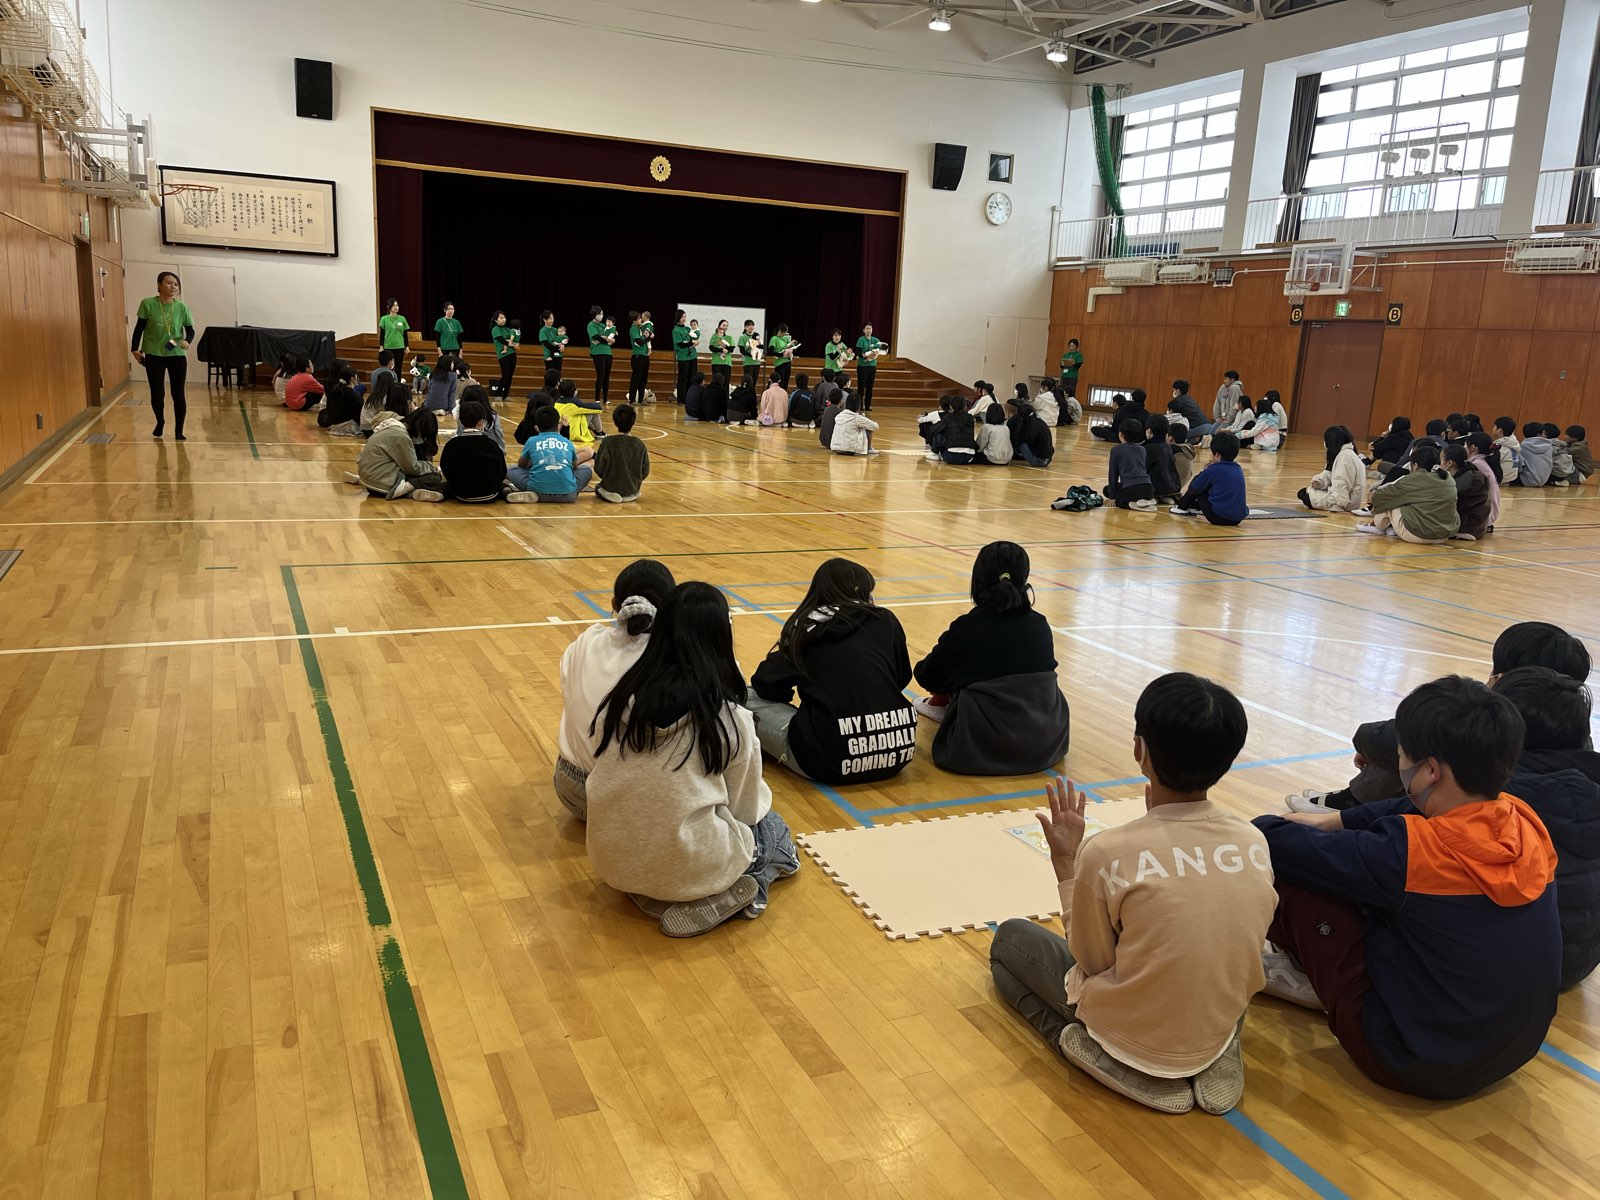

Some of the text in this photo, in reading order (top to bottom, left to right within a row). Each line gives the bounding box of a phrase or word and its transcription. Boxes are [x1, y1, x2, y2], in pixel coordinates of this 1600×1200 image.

[1293, 309, 1300, 320] B
[1391, 309, 1399, 320] B
[536, 440, 569, 452] KEBOZ
[838, 716, 861, 736] MY
[865, 707, 911, 732] DREAM
[841, 751, 897, 776] COMING
